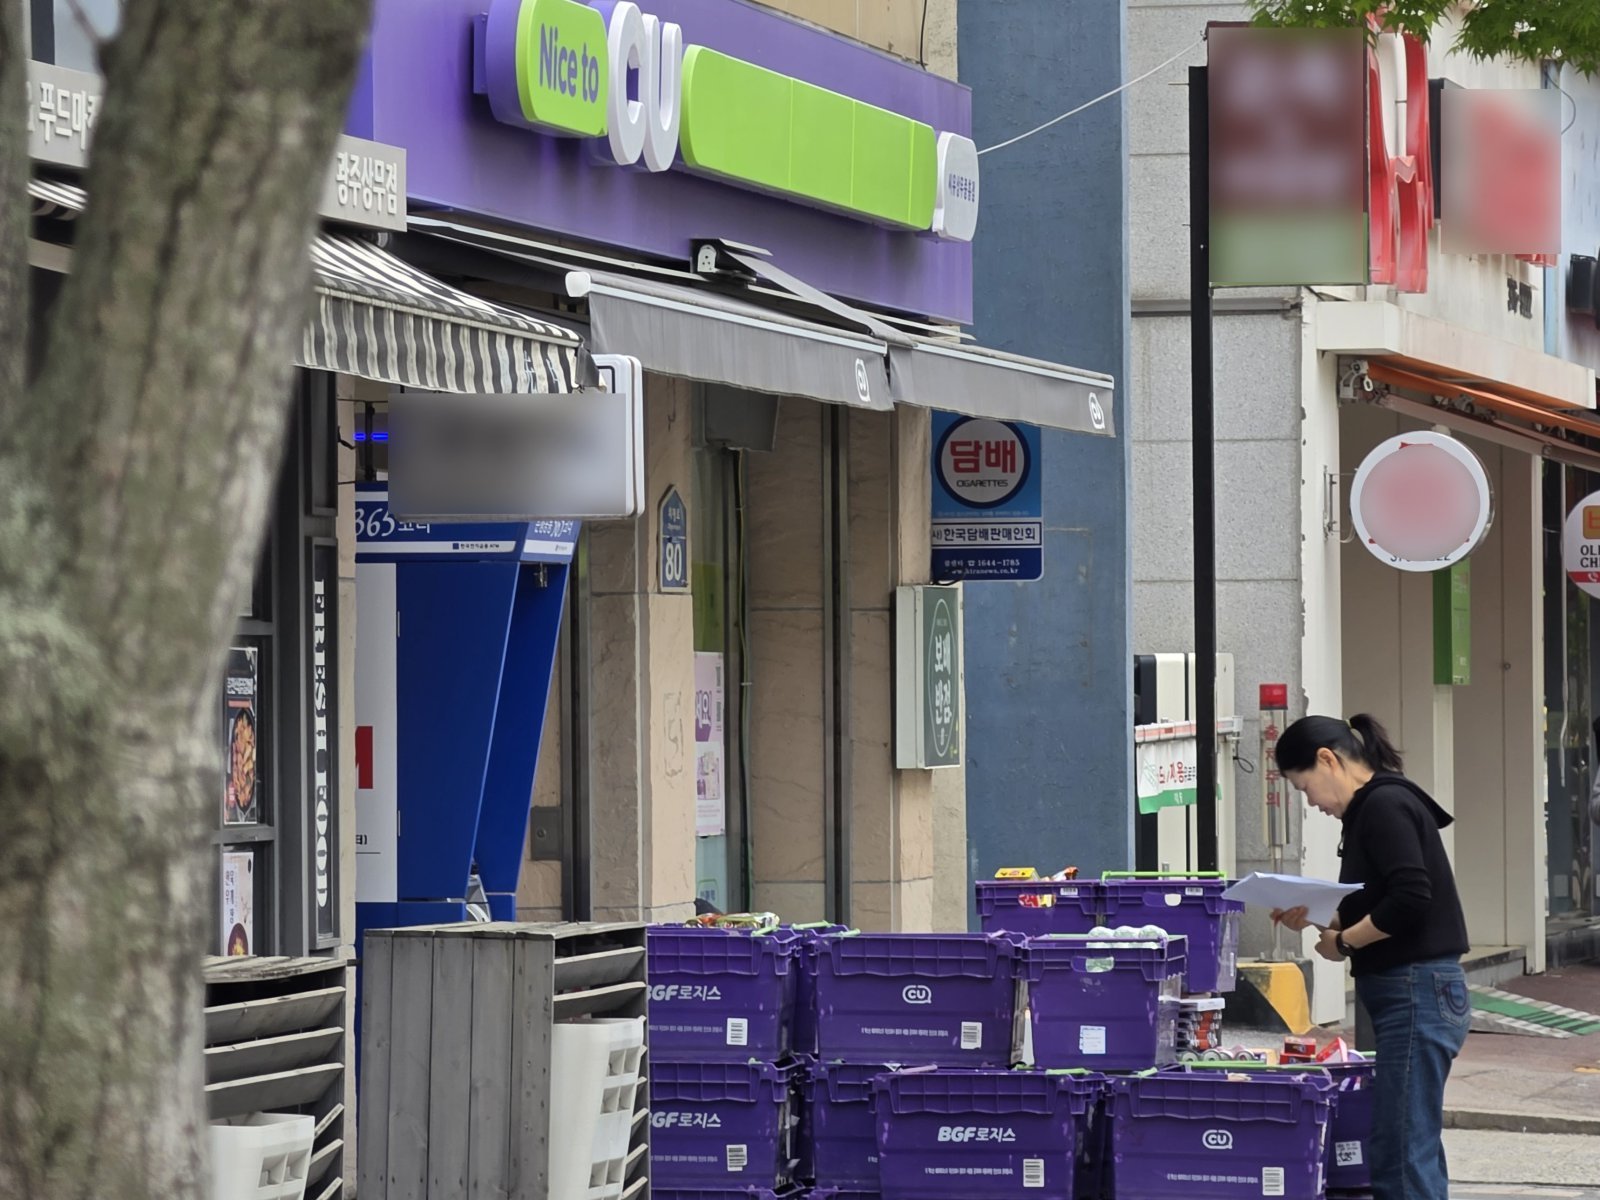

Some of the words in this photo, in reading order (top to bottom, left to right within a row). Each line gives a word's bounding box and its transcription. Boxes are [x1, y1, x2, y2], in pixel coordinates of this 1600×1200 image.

[540, 22, 578, 97] Nice
[582, 42, 599, 104] to
[607, 1, 683, 173] CU
[26, 81, 102, 151] 푸드마
[336, 151, 397, 215] 광주상무점
[950, 440, 1016, 473] 담배
[956, 479, 1009, 488] CIGARETTES
[665, 542, 683, 582] 80
[1580, 545, 1600, 556] OL
[314, 579, 328, 752] FRESH
[315, 771, 329, 908] FOOD
[649, 1111, 722, 1129] GF로지스
[937, 1126, 1016, 1143] BGF로지스
